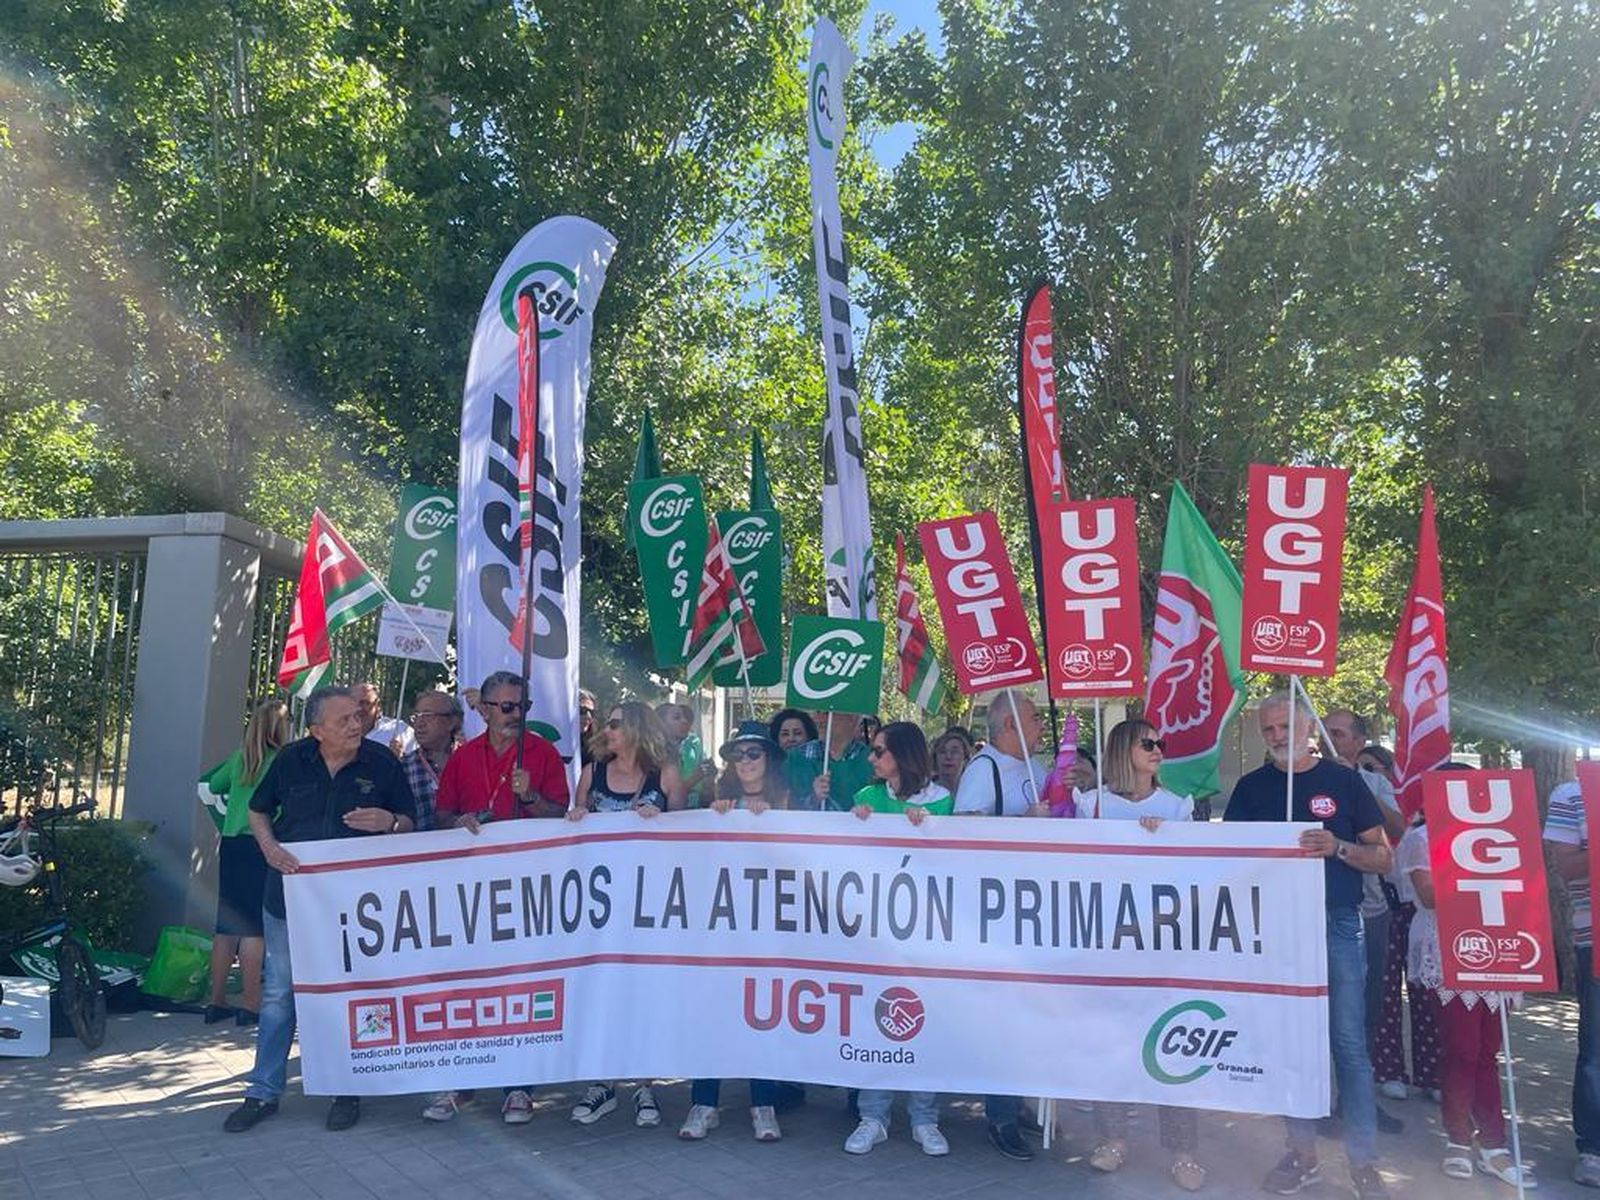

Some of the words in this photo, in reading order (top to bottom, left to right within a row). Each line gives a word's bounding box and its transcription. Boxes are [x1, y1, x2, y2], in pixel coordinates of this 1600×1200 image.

[416, 508, 457, 529] CSIF
[651, 498, 694, 520] CSIF
[731, 531, 773, 549] CSIF
[1263, 475, 1325, 614] UGT
[935, 522, 1005, 639] UGT
[1060, 508, 1120, 641] UGT
[1256, 621, 1283, 639] UGT
[1289, 625, 1310, 636] FSP
[808, 649, 872, 678] CSIF
[1064, 650, 1091, 665] UGT
[1097, 650, 1117, 660] FSP
[1445, 779, 1524, 927] UGT
[340, 865, 612, 972] ¡SALVEMOS
[633, 865, 689, 930] LA
[708, 854, 954, 942] ATENCIÓN
[979, 877, 1262, 954] PRIMARIA!
[1497, 938, 1520, 950] FSP
[414, 993, 530, 1032] CCOO
[744, 977, 863, 1037] UGT
[350, 1047, 401, 1060] sindicato
[404, 1038, 457, 1057] provincial
[459, 1038, 473, 1050] de
[475, 1034, 514, 1049] sanidad
[524, 1032, 563, 1045] sectores
[839, 1042, 915, 1064] Granada
[1161, 1025, 1238, 1058] CSIF
[352, 1055, 435, 1074] sociosanitarios
[437, 1057, 451, 1068] de
[453, 1054, 497, 1066] Granada
[1216, 1062, 1264, 1075] Granada
